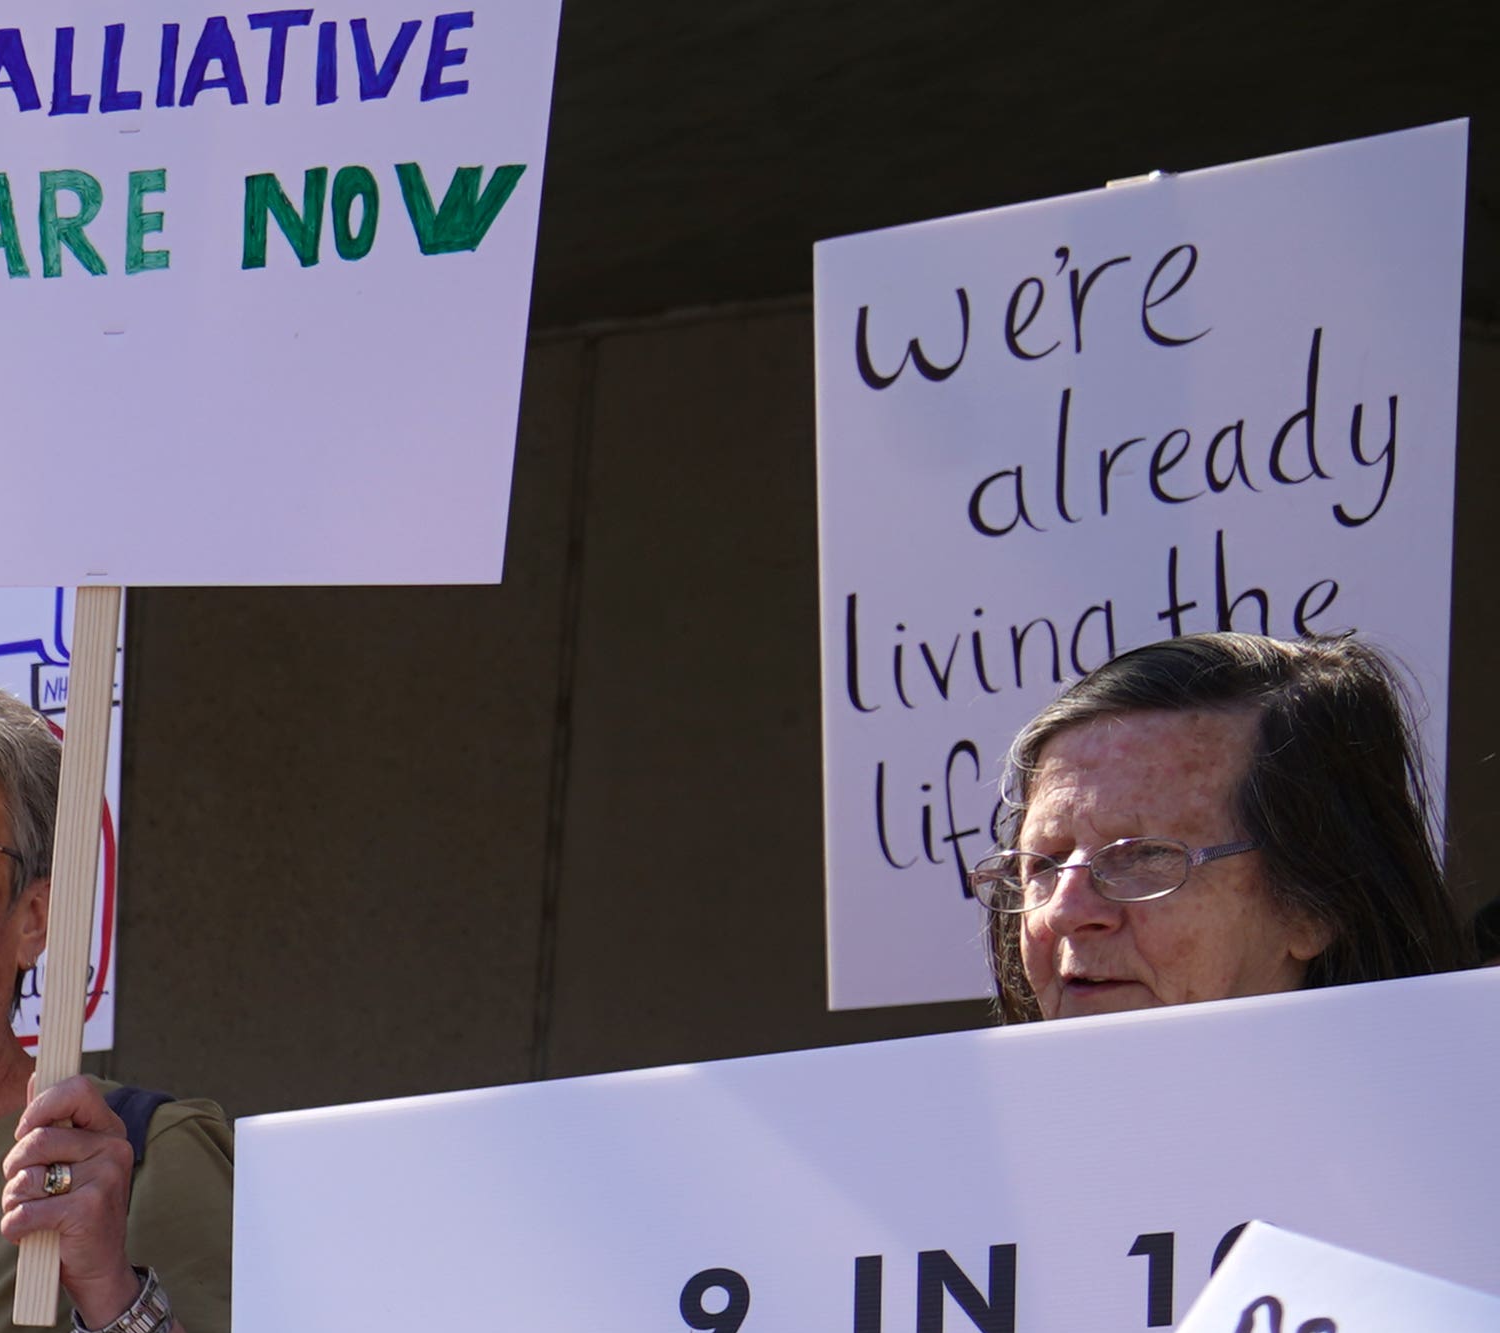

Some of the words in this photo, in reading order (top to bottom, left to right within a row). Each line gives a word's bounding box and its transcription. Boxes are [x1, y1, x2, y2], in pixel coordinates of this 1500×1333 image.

[241, 161, 528, 271] NOW
[967, 325, 1401, 539] already
[1156, 528, 1360, 642] the
[43, 676, 69, 704] NH
[1126, 1220, 1268, 1328] 1
